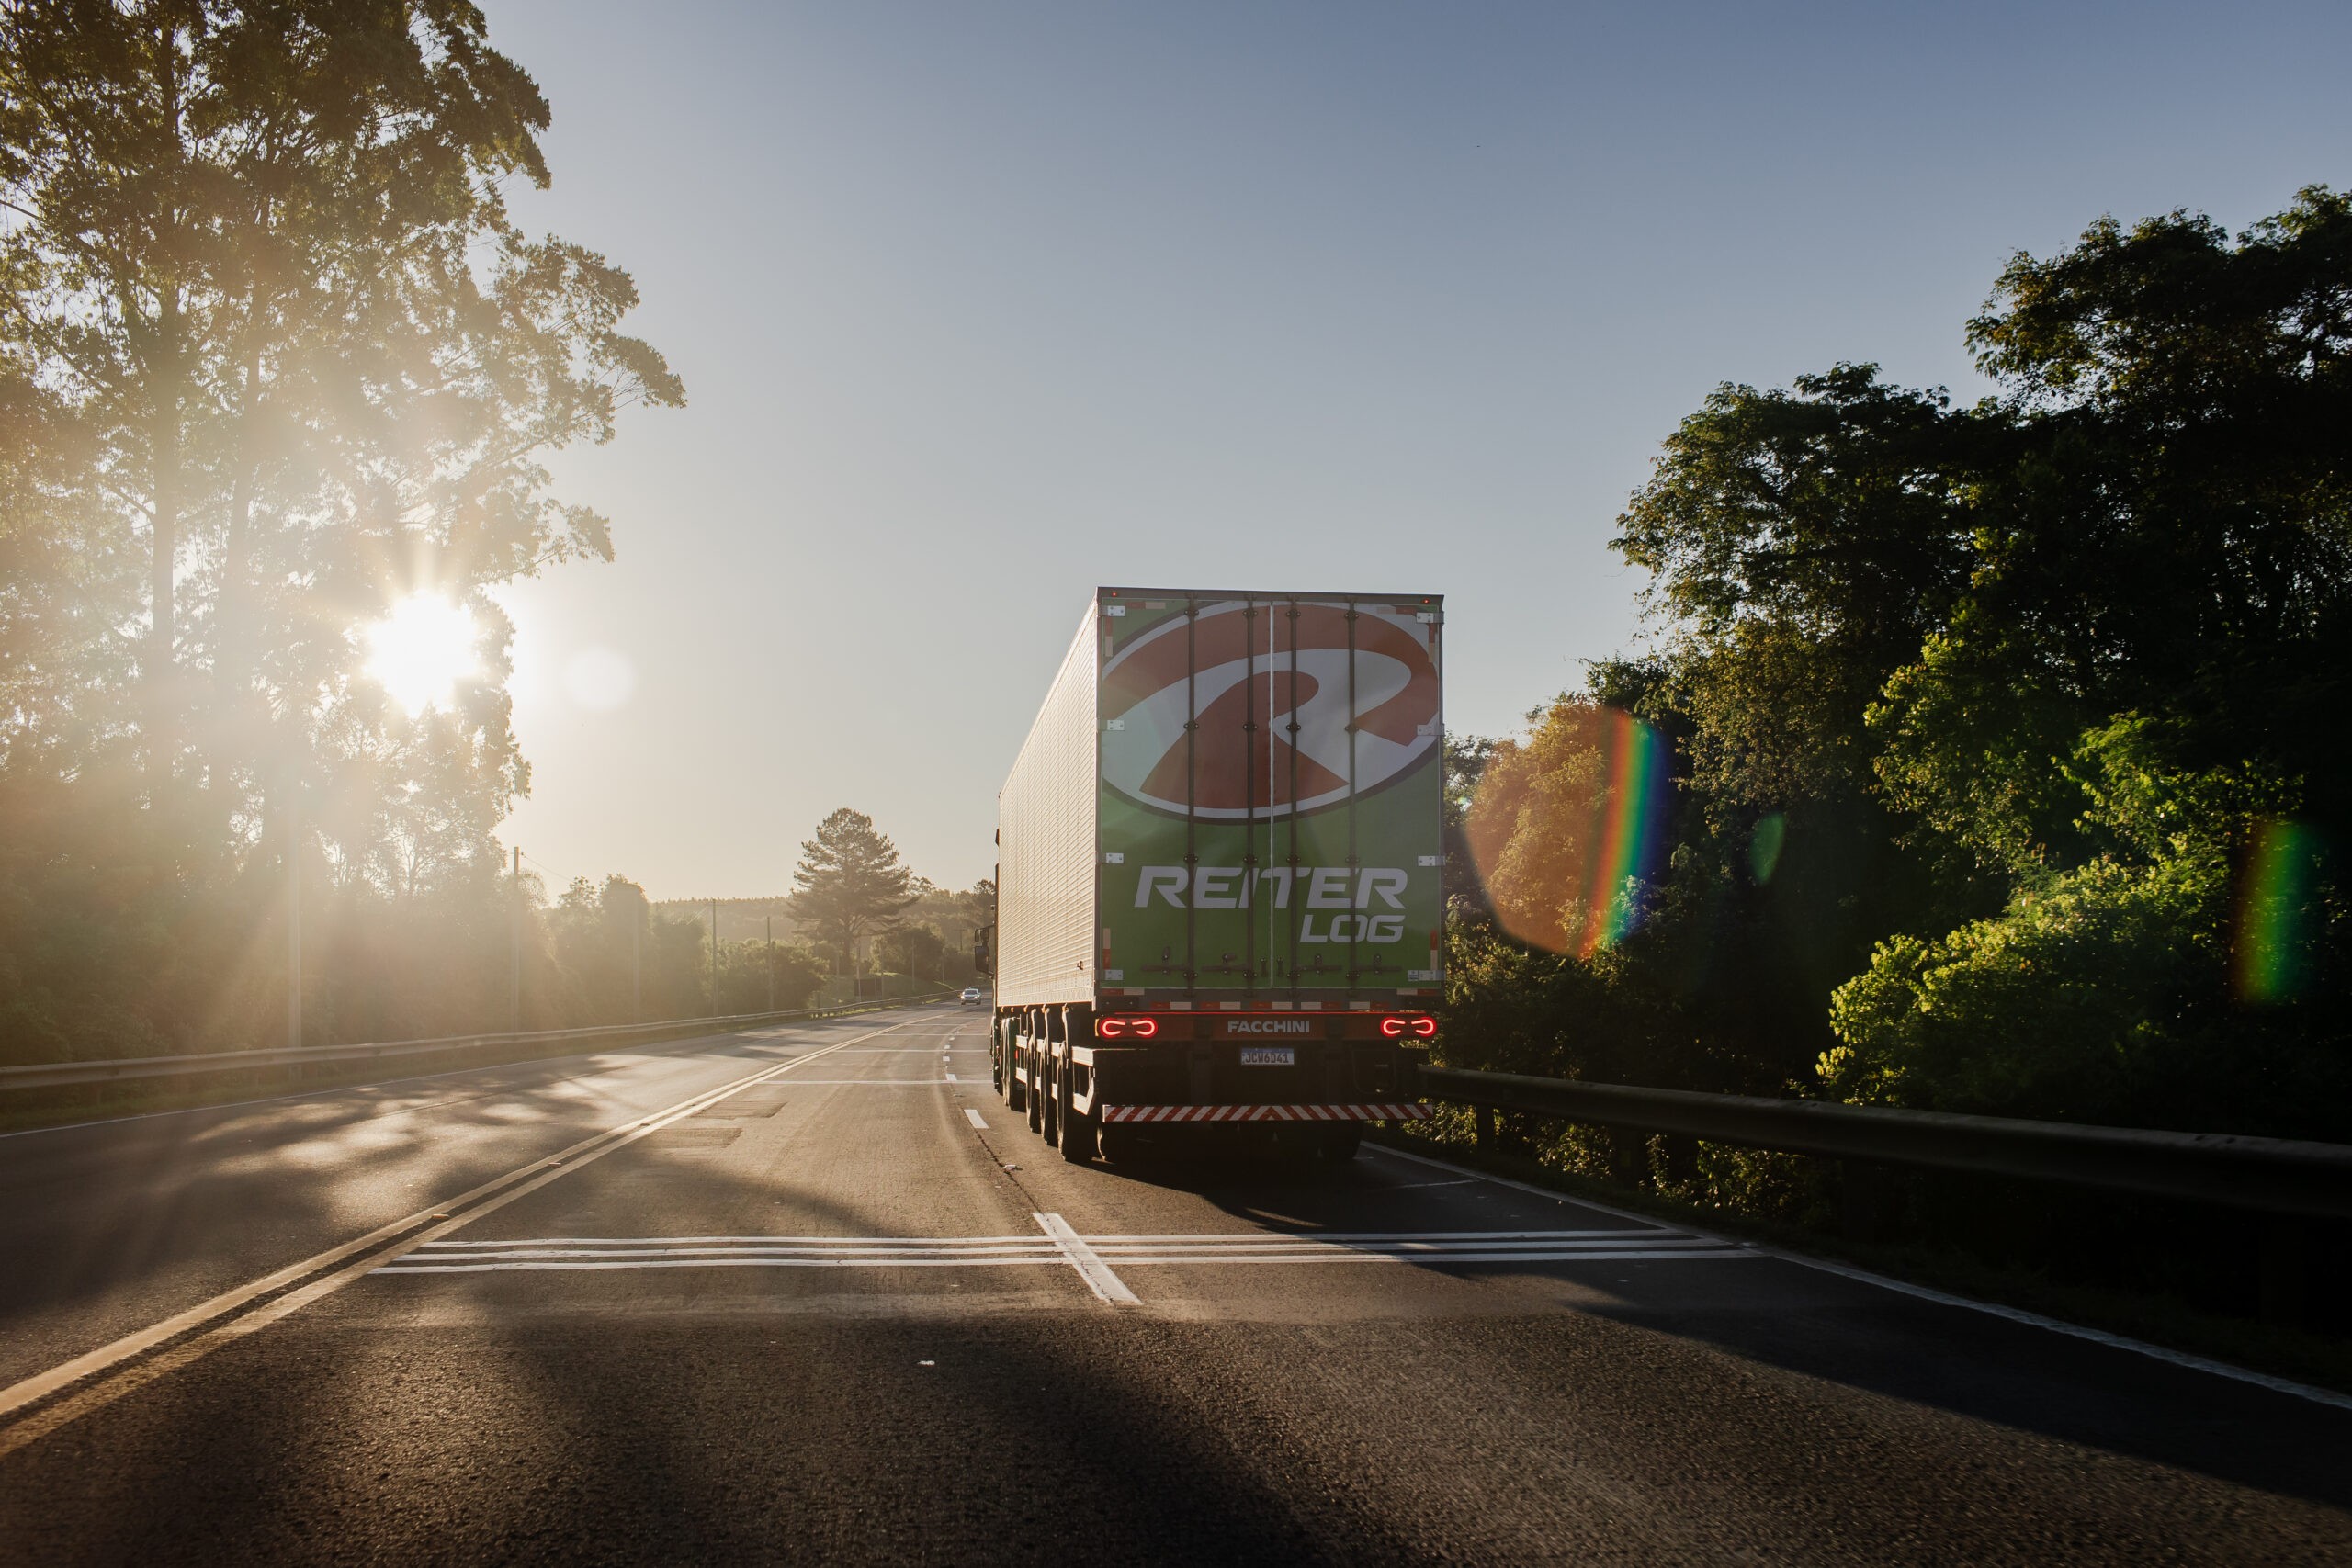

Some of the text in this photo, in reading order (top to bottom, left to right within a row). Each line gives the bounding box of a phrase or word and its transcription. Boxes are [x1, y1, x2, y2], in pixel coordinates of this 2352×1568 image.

[1102, 614, 1439, 818] R
[1134, 865, 1407, 909] REITER
[1299, 914, 1406, 943] LOG
[1227, 1021, 1310, 1033] FACCHINI
